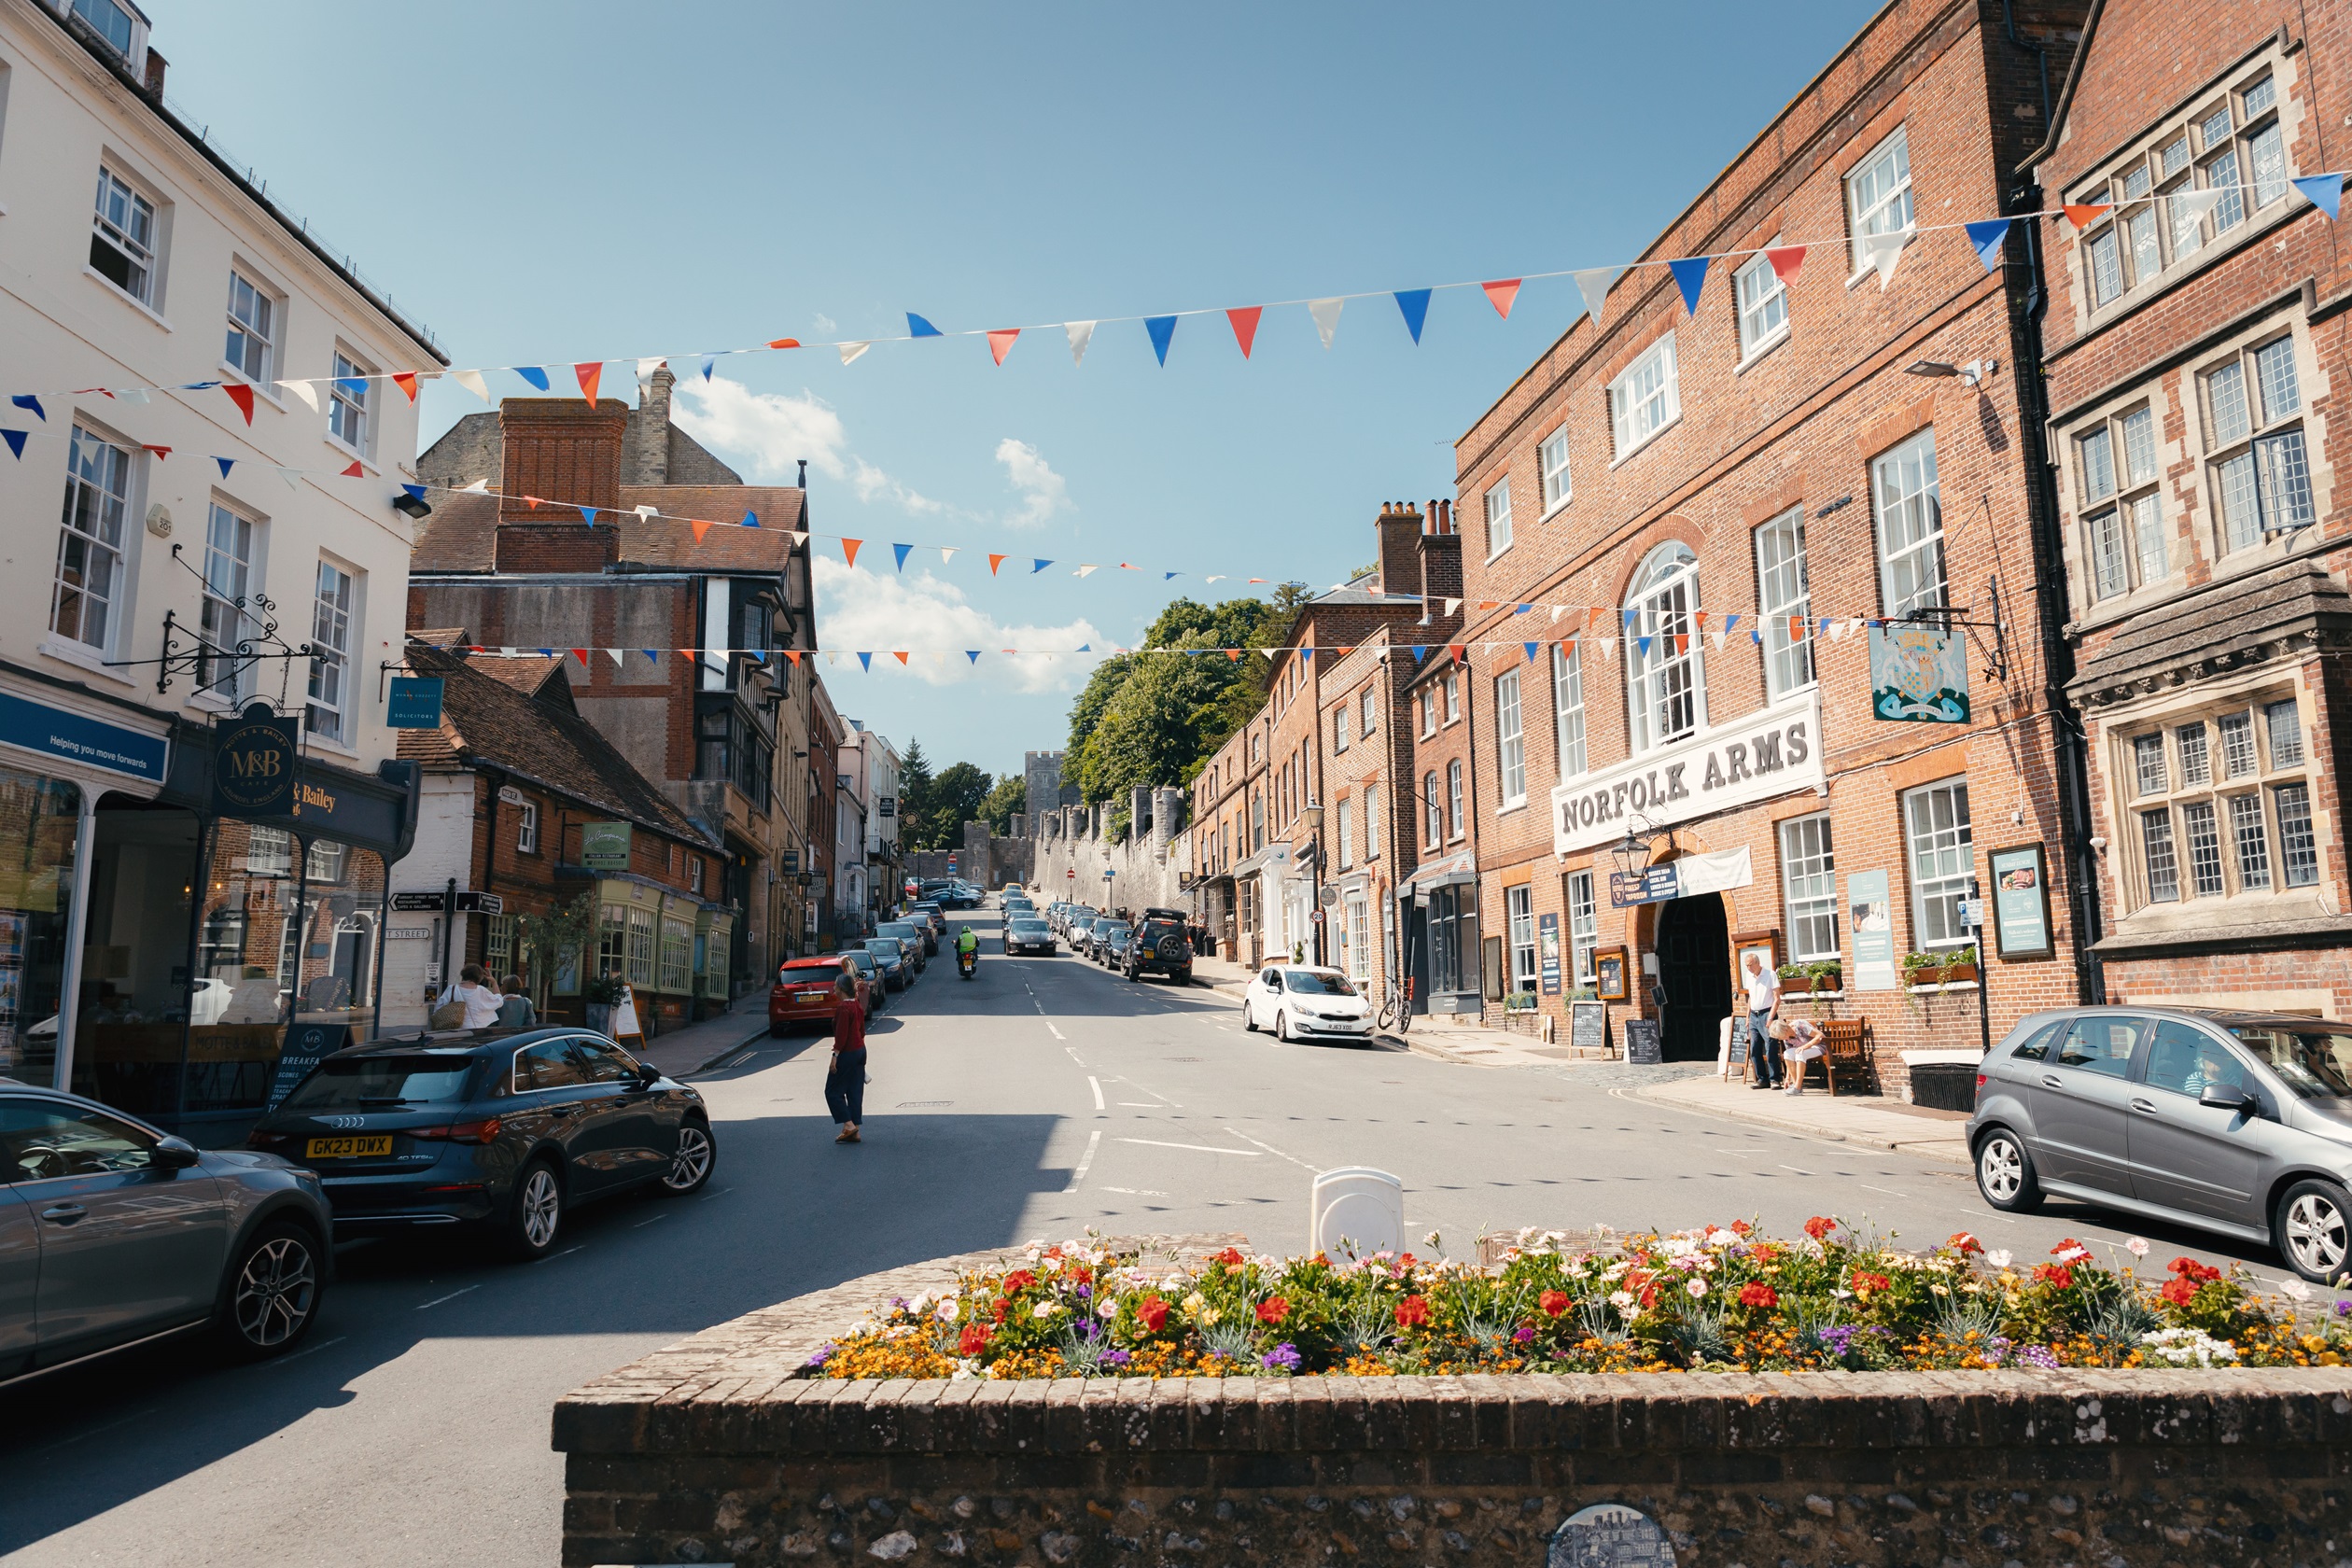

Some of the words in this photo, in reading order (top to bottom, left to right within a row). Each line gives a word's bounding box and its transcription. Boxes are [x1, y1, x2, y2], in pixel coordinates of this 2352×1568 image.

[159, 520, 172, 533] 201
[225, 731, 247, 750] MOTTE
[262, 729, 287, 747] BAILEY
[49, 735, 80, 753] Helping
[80, 744, 95, 755] you
[96, 749, 117, 761] move
[117, 753, 147, 769] forwards
[229, 749, 281, 778] M&B
[1561, 761, 1689, 834] NORFOLK
[1701, 721, 1809, 791] ARMS
[223, 785, 250, 805] ARUNDEL
[253, 784, 284, 804] ENGLAND
[301, 784, 336, 814] Bailey
[1625, 891, 1647, 902] TAPROOM
[304, 1035, 320, 1043] MB
[282, 1057, 320, 1065] BREAKFA
[314, 1140, 353, 1155] GK23
[357, 1137, 386, 1153] DWX
